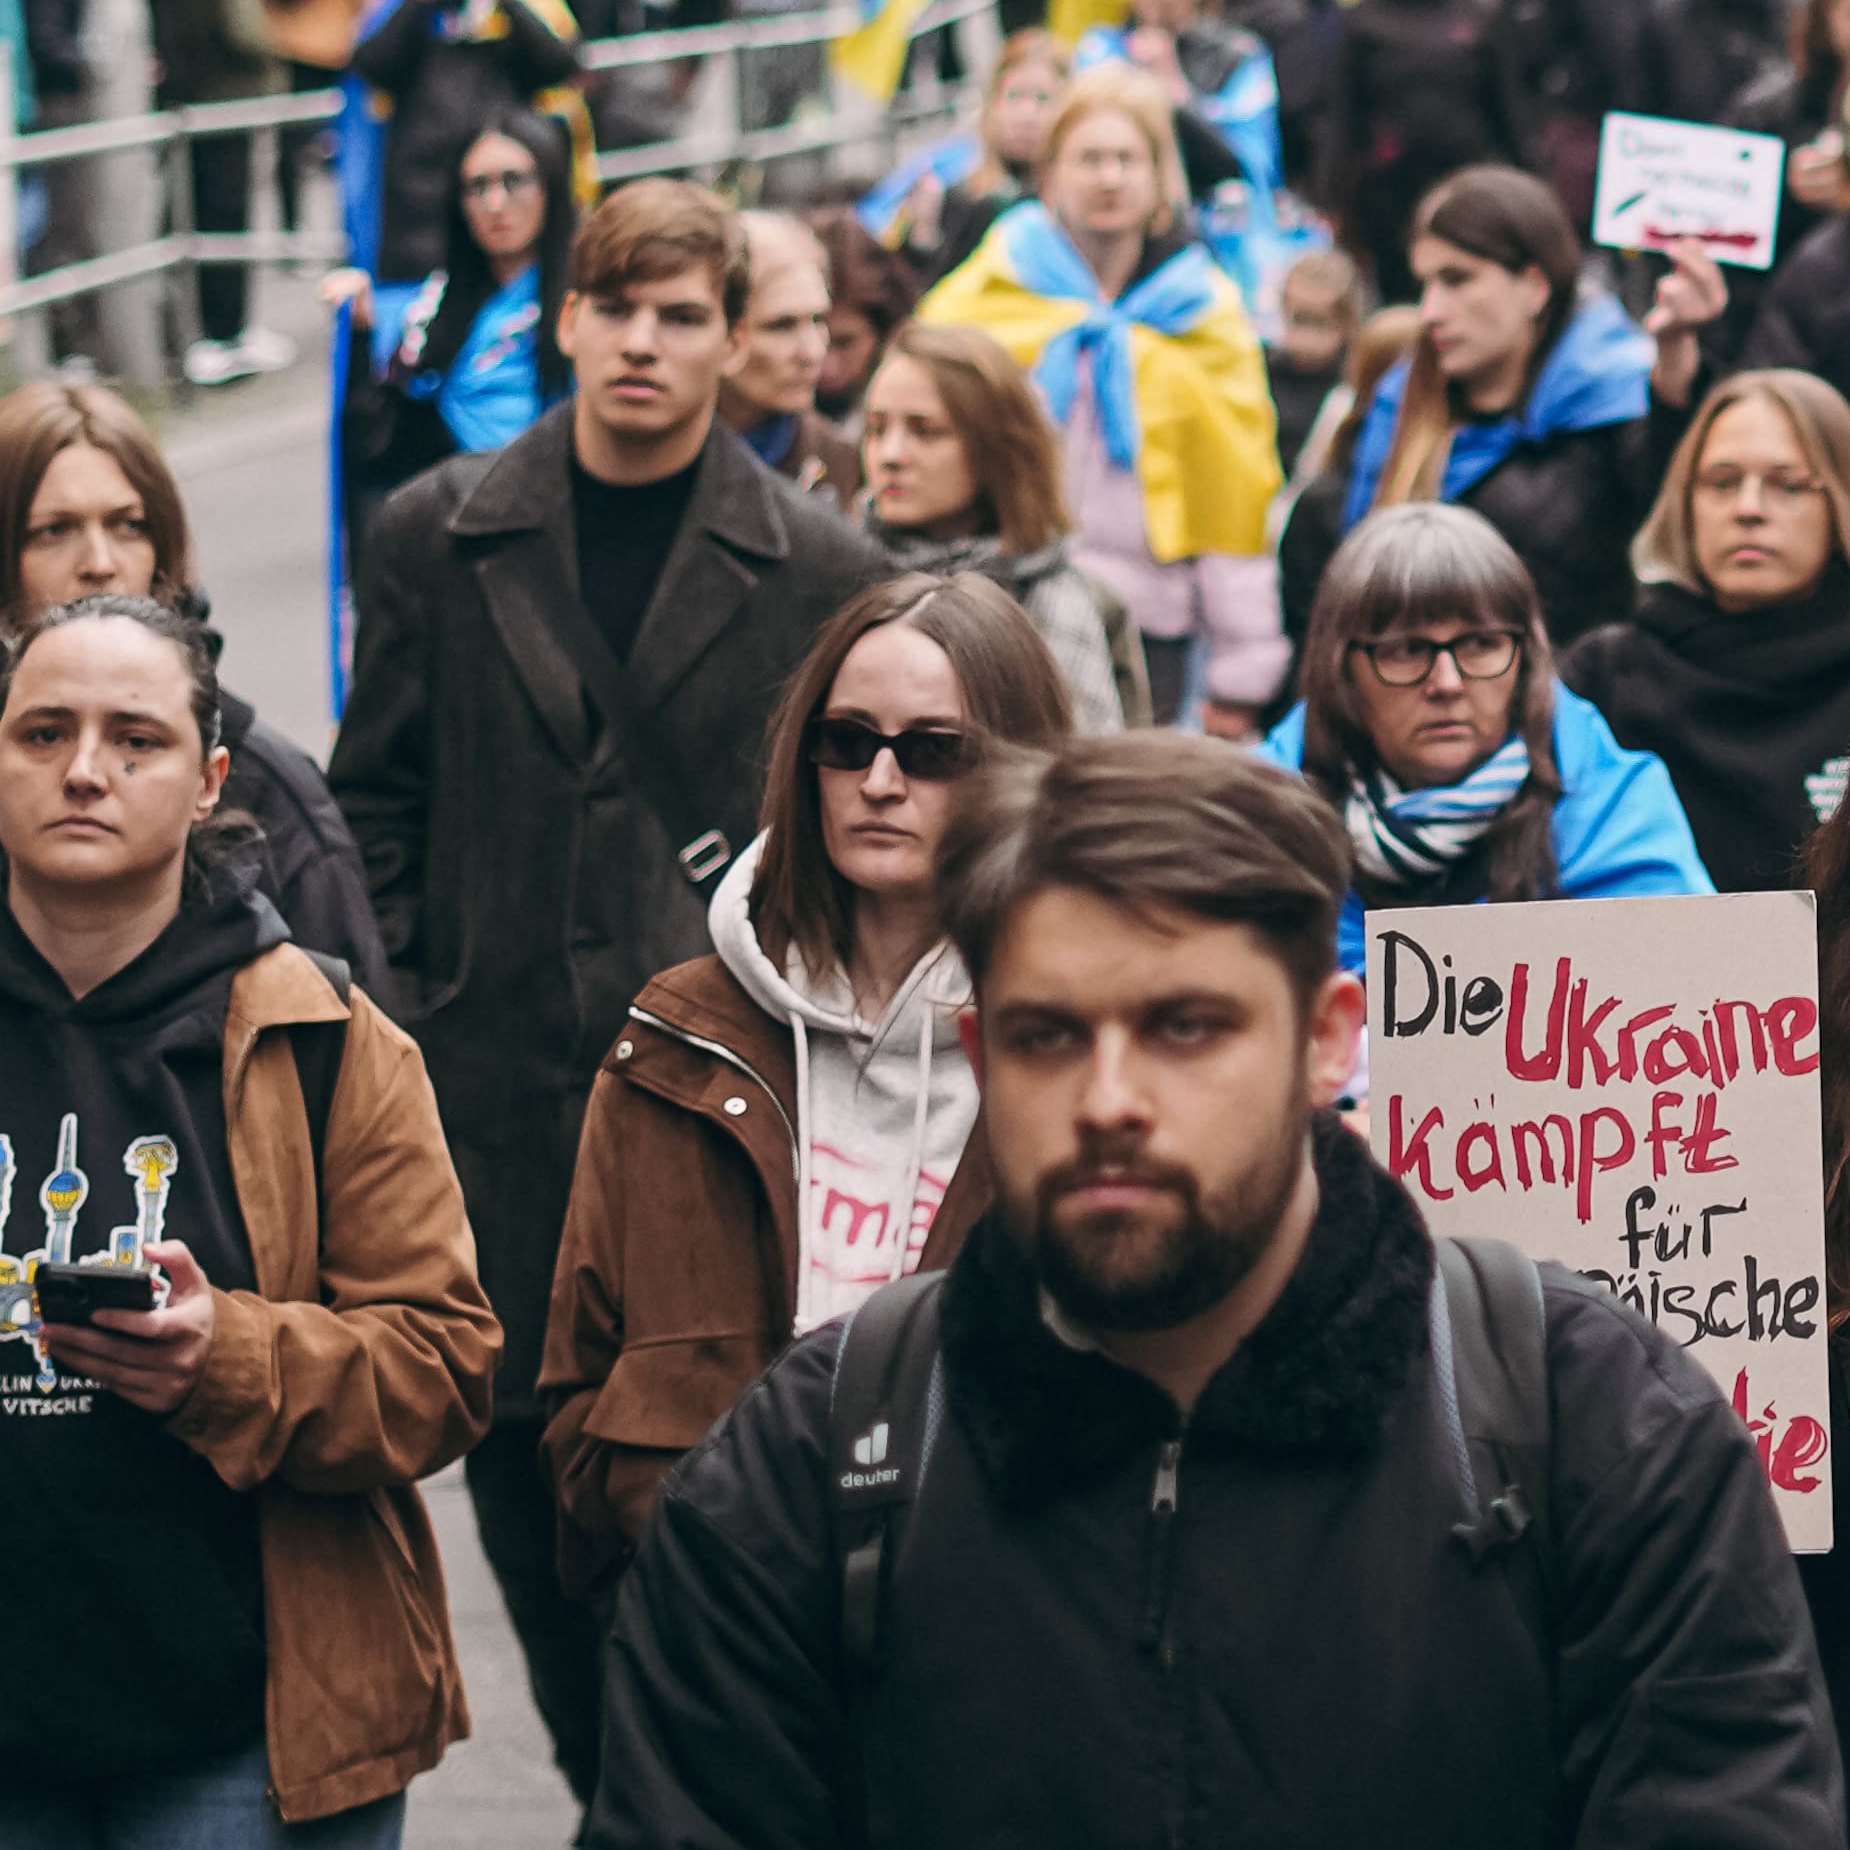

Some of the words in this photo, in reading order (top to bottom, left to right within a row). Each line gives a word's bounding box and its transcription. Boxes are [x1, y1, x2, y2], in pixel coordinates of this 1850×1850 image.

[1376, 930, 1504, 1038] Die
[1505, 957, 1819, 1089] Ukraine
[1619, 1186, 1747, 1270] für
[841, 1469, 900, 1488] deuter
